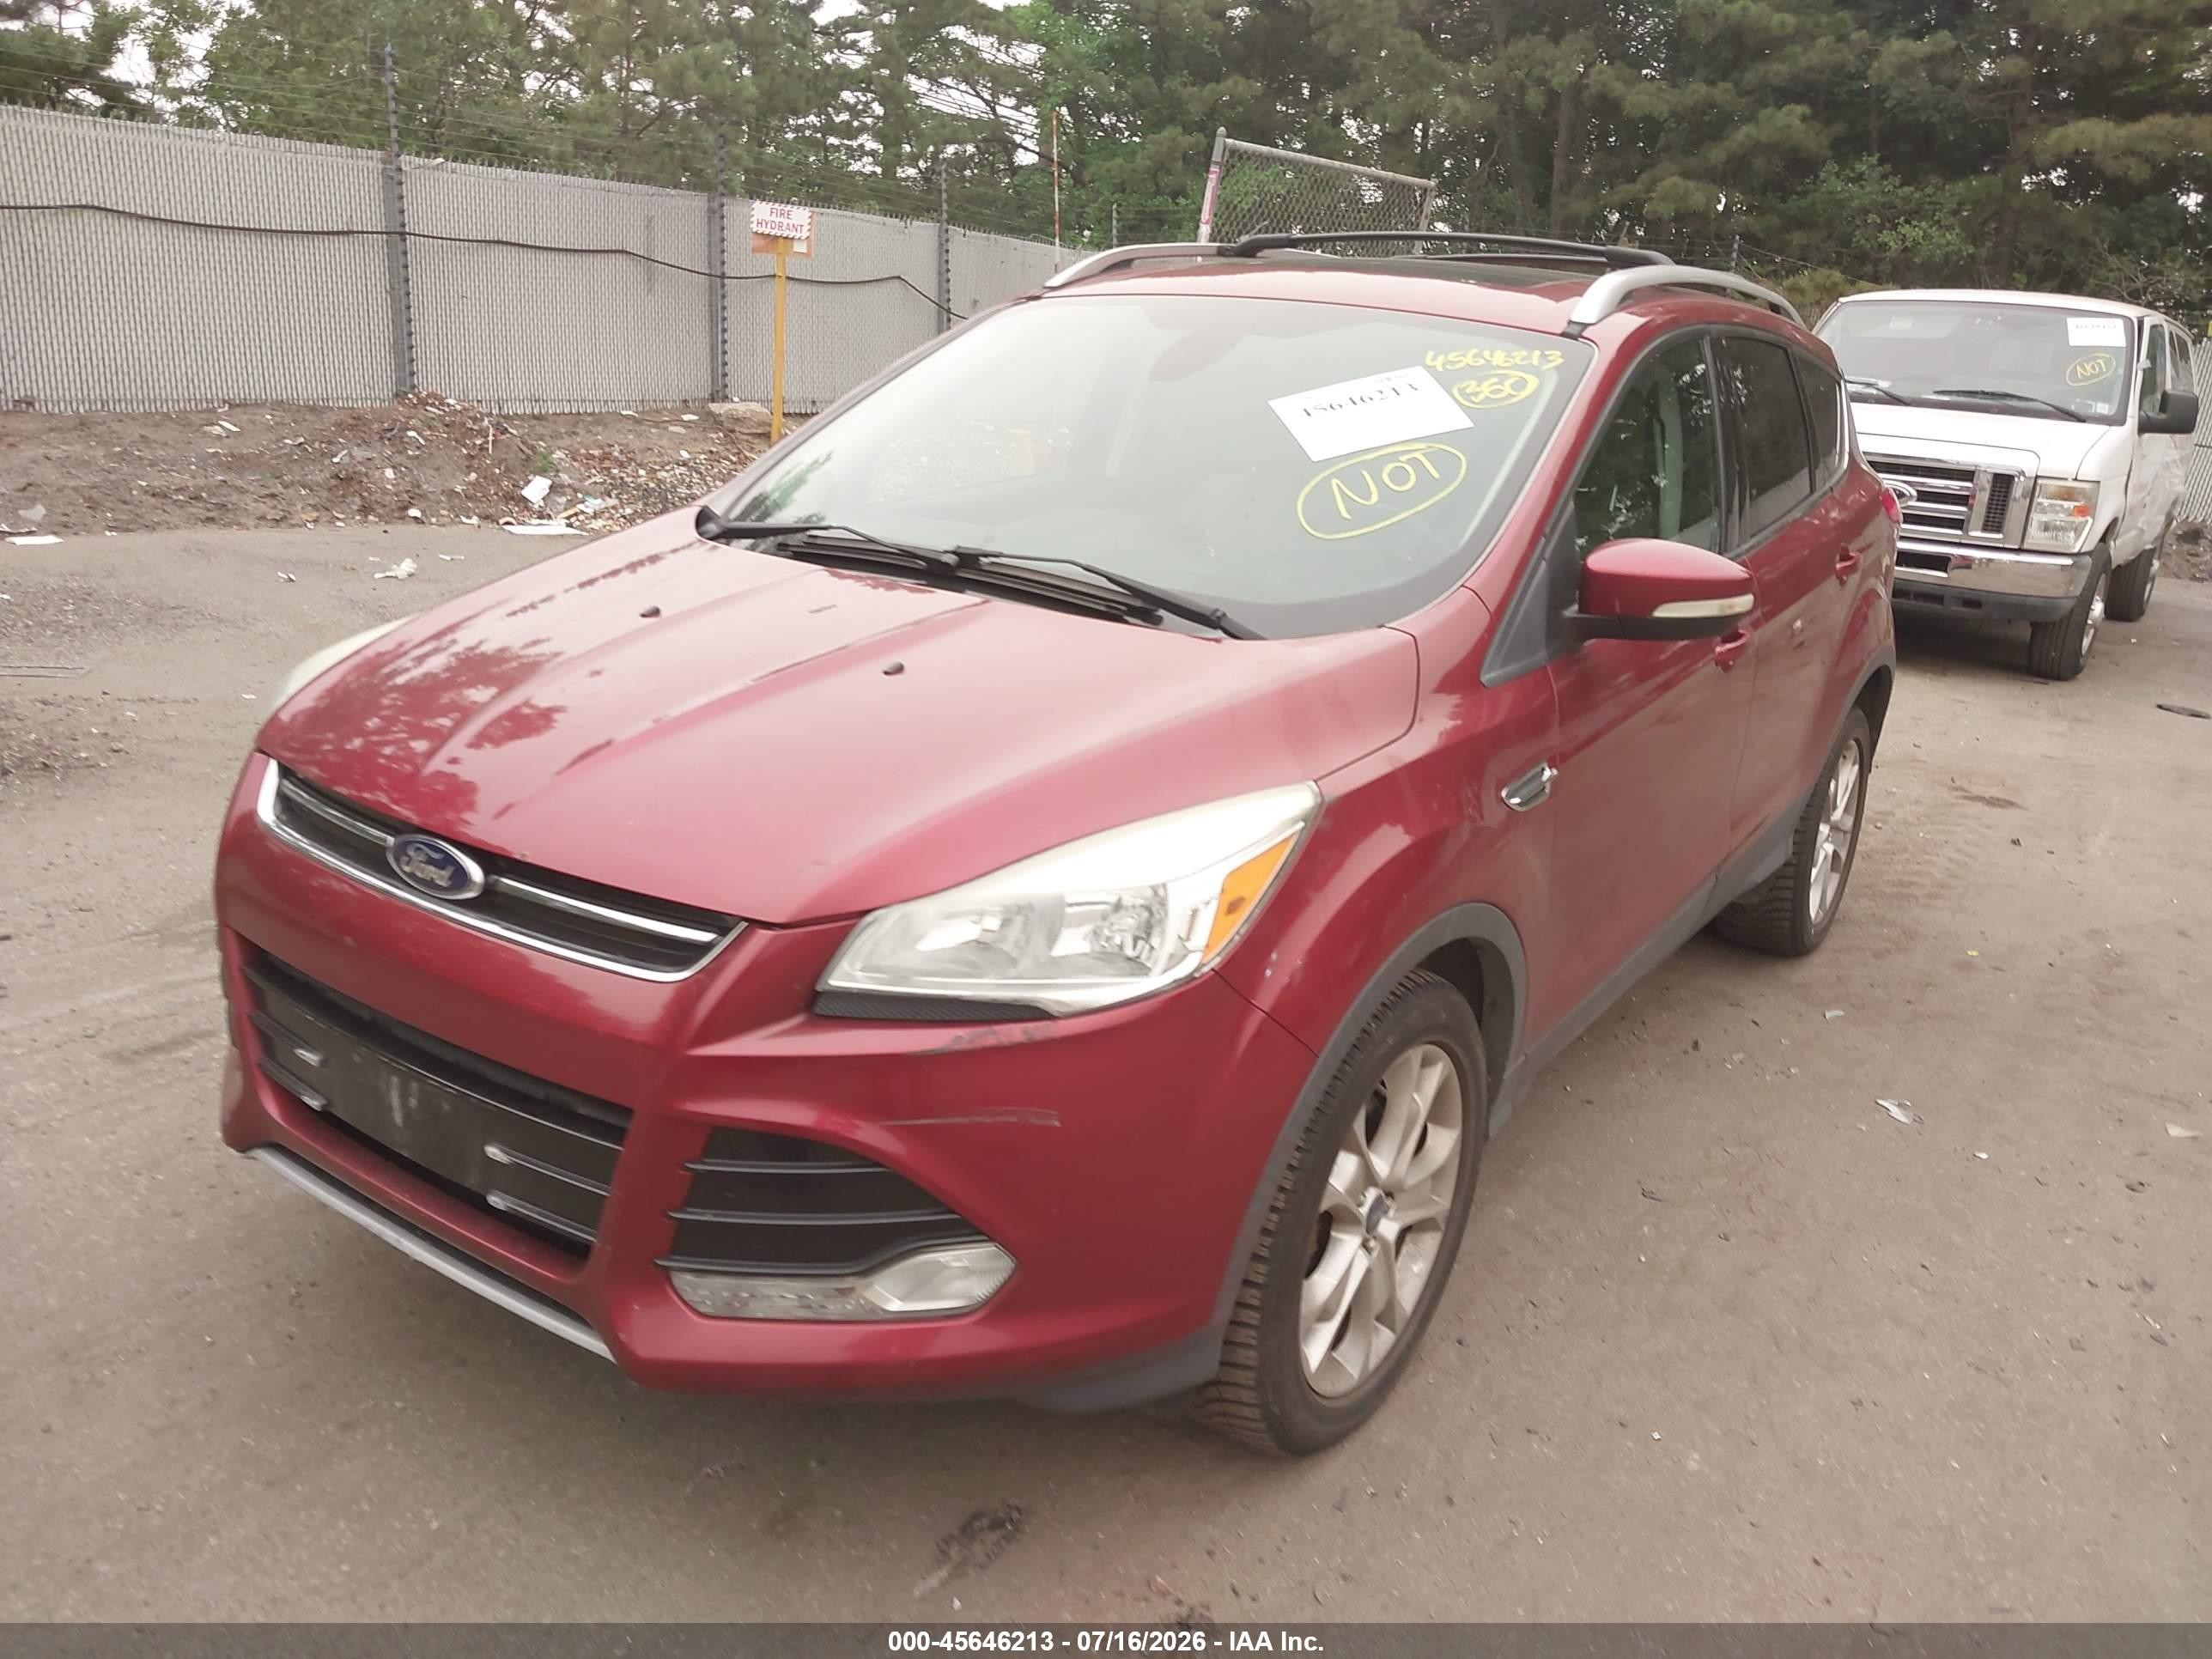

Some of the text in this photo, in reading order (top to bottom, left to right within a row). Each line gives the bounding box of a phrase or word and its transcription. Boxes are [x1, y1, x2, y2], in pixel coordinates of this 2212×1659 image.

[769, 207, 793, 220] FIRE
[756, 218, 805, 234] HYDRANT
[1425, 348, 1565, 372] 45646213
[2075, 359, 2106, 379] NOT
[1331, 452, 1440, 520] NOT
